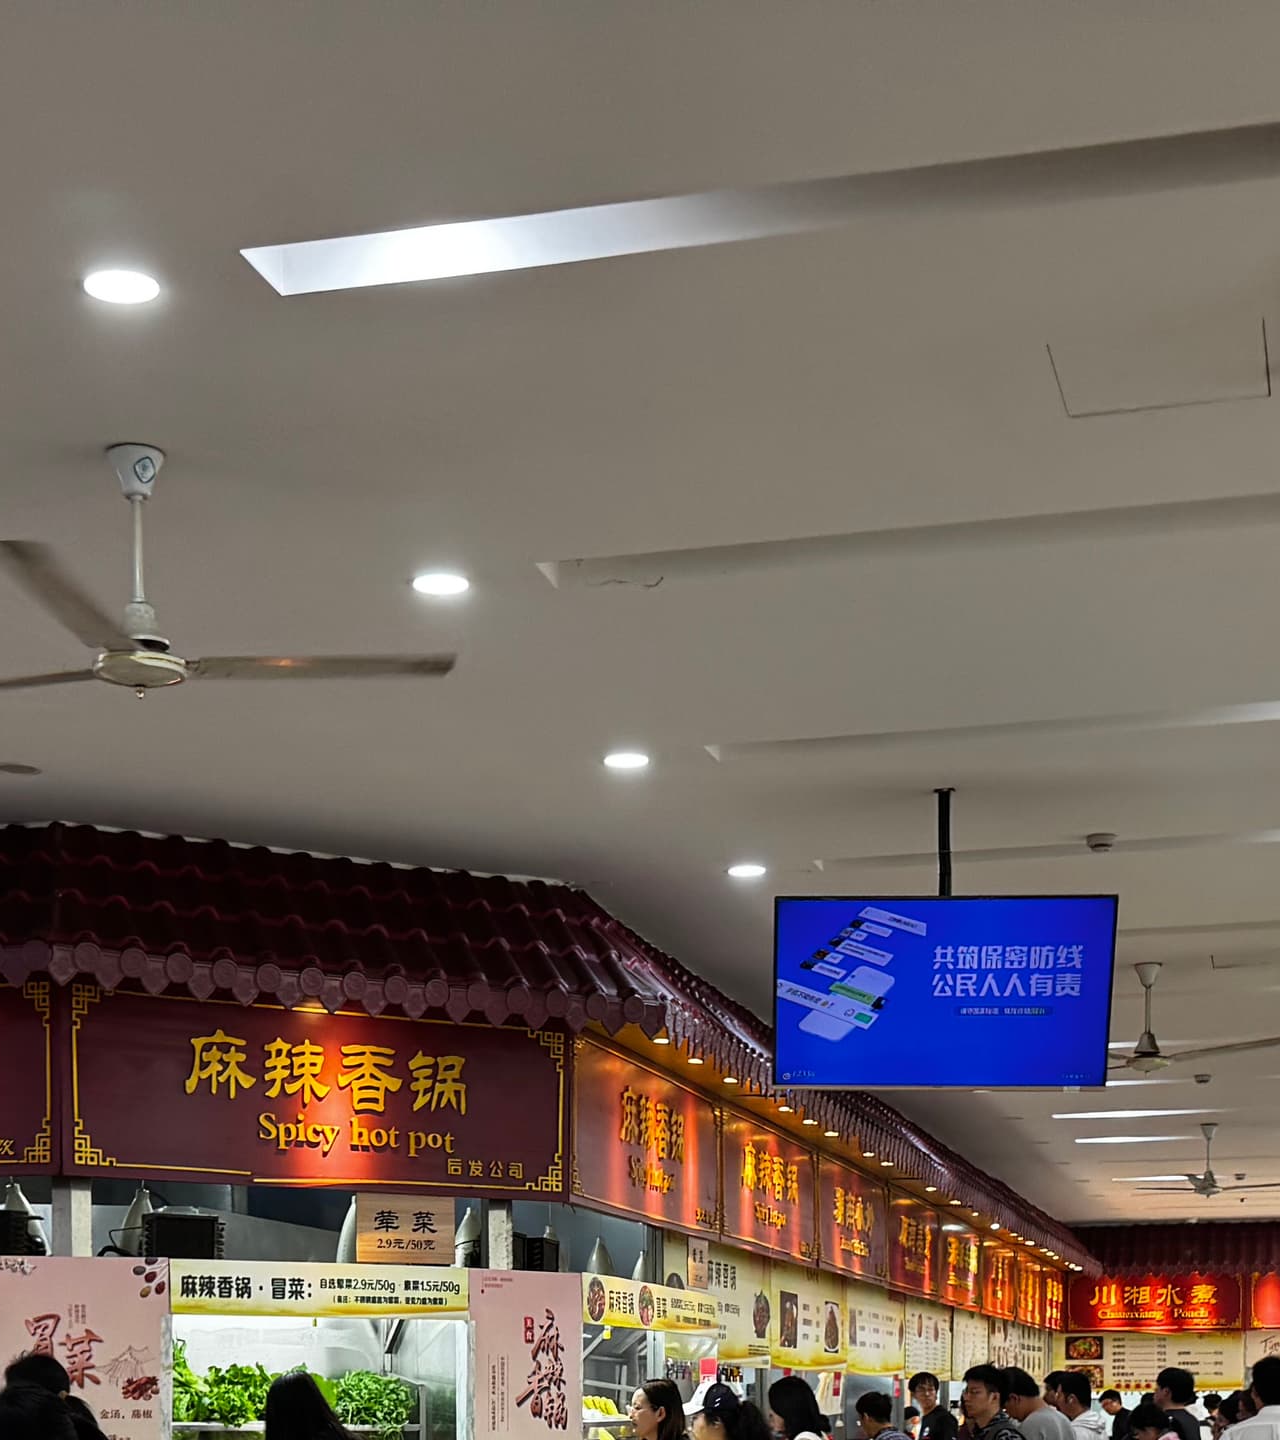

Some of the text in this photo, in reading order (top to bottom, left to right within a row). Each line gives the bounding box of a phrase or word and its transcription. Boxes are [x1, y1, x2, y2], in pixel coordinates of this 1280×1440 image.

[933, 945, 1084, 970] 共筑保密防线
[932, 973, 1082, 997] 公民人人有责
[185, 1029, 467, 1116] 麻辣香锅
[259, 1112, 456, 1158] Spicy hot pot
[447, 1158, 524, 1179] 后发公司
[373, 1210, 438, 1234] 荤菜
[377, 1238, 437, 1251] 2.9元/50克
[1089, 1283, 1218, 1307] 川湘水煮
